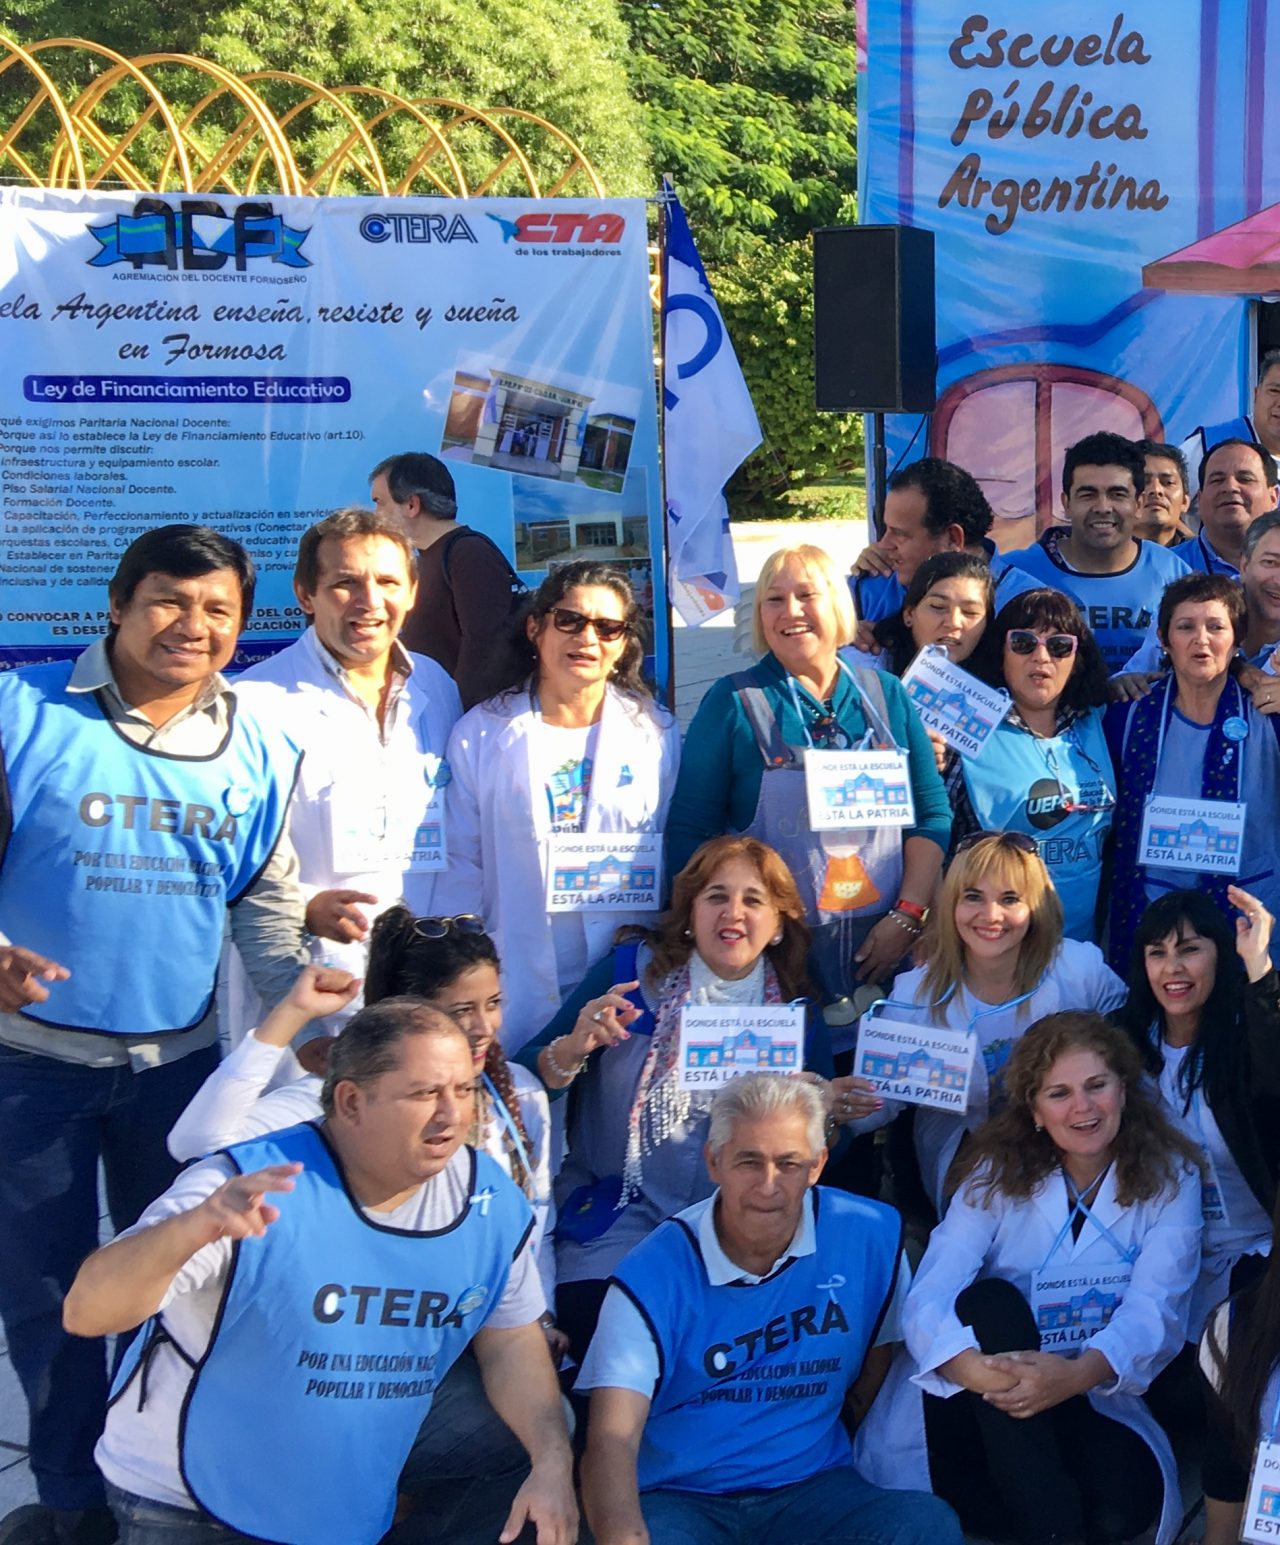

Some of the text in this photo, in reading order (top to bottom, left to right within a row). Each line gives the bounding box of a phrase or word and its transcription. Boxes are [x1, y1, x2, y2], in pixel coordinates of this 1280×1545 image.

[949, 13, 1152, 69] Escuela
[950, 79, 1148, 147] Pública
[938, 152, 1169, 235] Argentina
[359, 213, 478, 243] CTERA
[514, 213, 626, 243] CTA
[515, 247, 621, 258] de los trabajadores
[182, 273, 200, 283] DEL
[202, 274, 248, 284] DOCENTE
[250, 273, 307, 286] FORMOSEÑO
[51, 291, 201, 330] Argentina
[213, 297, 312, 325] enseña,
[318, 301, 404, 325] resiste
[415, 307, 433, 331] y
[444, 297, 520, 324] sueña
[118, 332, 288, 367] en Formosa
[32, 380, 345, 400] Ley de Financiamiento Educativo
[25, 417, 231, 428] exigimos Paritaria Nacional Docente:
[60, 431, 70, 441] lo
[73, 431, 126, 441] establece
[129, 431, 139, 441] la
[142, 432, 161, 442] Ley
[164, 431, 178, 440] de
[181, 431, 267, 440] Financiamiento
[270, 431, 321, 441] Educativo
[40, 446, 60, 454] nos
[63, 444, 107, 455] permite
[98, 458, 174, 469] equipamiento
[178, 458, 220, 468] escolar.
[2, 470, 128, 481] Condiciones laborales.
[3, 484, 177, 494] Piso Salarial Nacional Docente.
[3, 496, 116, 508] Formación Docente.
[83, 509, 291, 521] Perfeccionamiento actualización en
[5, 522, 307, 535] La aplicación de (Conectar
[245, 535, 298, 545] educativa
[7, 550, 83, 561] Establecer en
[0, 564, 115, 574] Nacional de sostener
[60, 576, 74, 586] de
[7, 612, 80, 622] CONVOCAR
[84, 612, 93, 621] A
[256, 608, 281, 618] DEL
[1080, 605, 1153, 630] ERA
[52, 626, 69, 635] ES
[920, 658, 1003, 714] DONDE ESTÁ ESCUELA
[925, 712, 940, 730] LA
[940, 722, 980, 753] PATRIA
[870, 761, 904, 771] ESCUELA
[79, 792, 238, 846] CTERA
[849, 807, 911, 820] LA PATRIA
[1150, 805, 1242, 822] DONDE ESTÁ ESCUELA
[585, 843, 657, 854] ESTÁ LA ESCUELA
[1145, 846, 1237, 867] ESTÁ LA PATRIA
[551, 891, 656, 906] ESTÁ LA PATRIA
[686, 1017, 796, 1028] DONDE ESTÁ LA ESCUELA
[864, 1028, 970, 1055] DONDE ESTÁ LA ESCUELA
[684, 1069, 719, 1082] ESTÁ
[894, 1081, 963, 1105] LA PATRIA
[1036, 1277, 1088, 1292] DONDE ESTÁ
[313, 1283, 466, 1330] CTERA
[703, 1299, 850, 1379] CTERA
[1070, 1328, 1087, 1342] LA
[297, 1350, 327, 1370] POR
[355, 1351, 413, 1373] EDUCACIÓN
[304, 1378, 365, 1400] POPULAR
